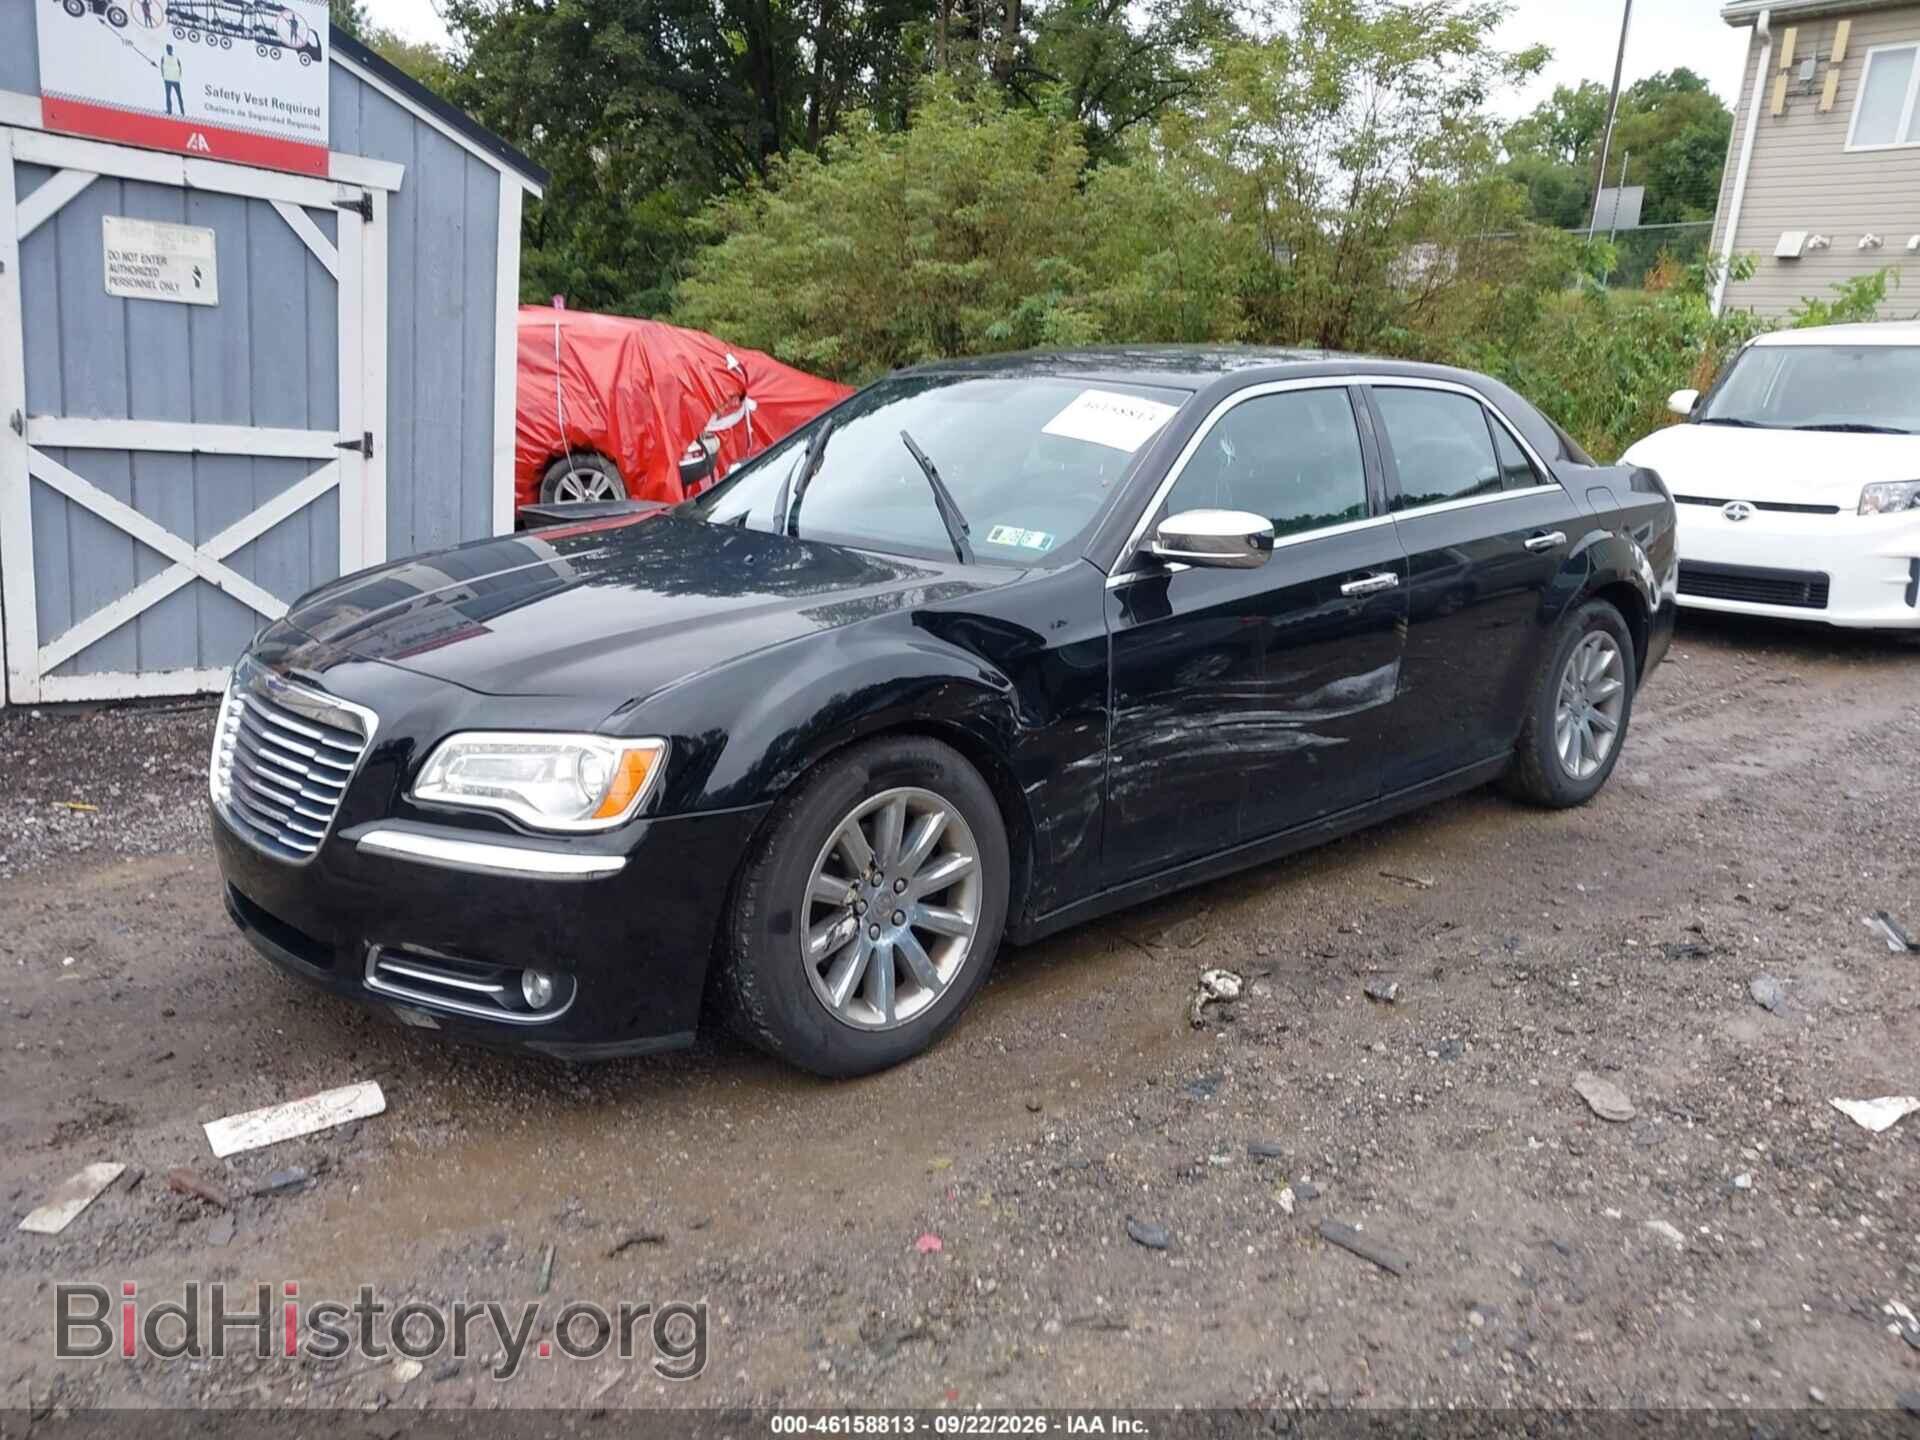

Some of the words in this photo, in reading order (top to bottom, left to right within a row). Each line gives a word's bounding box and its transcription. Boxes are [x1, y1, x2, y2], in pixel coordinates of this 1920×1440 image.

[204, 84, 241, 103] Safety
[243, 91, 268, 107] Vest
[271, 97, 321, 118] Required
[108, 249, 120, 261] DO
[121, 251, 139, 264] NOT
[141, 253, 168, 265] ENTER
[109, 263, 160, 278] AUTHORIZED
[109, 275, 158, 289] PERSONNEL
[159, 280, 180, 292] ONLY
